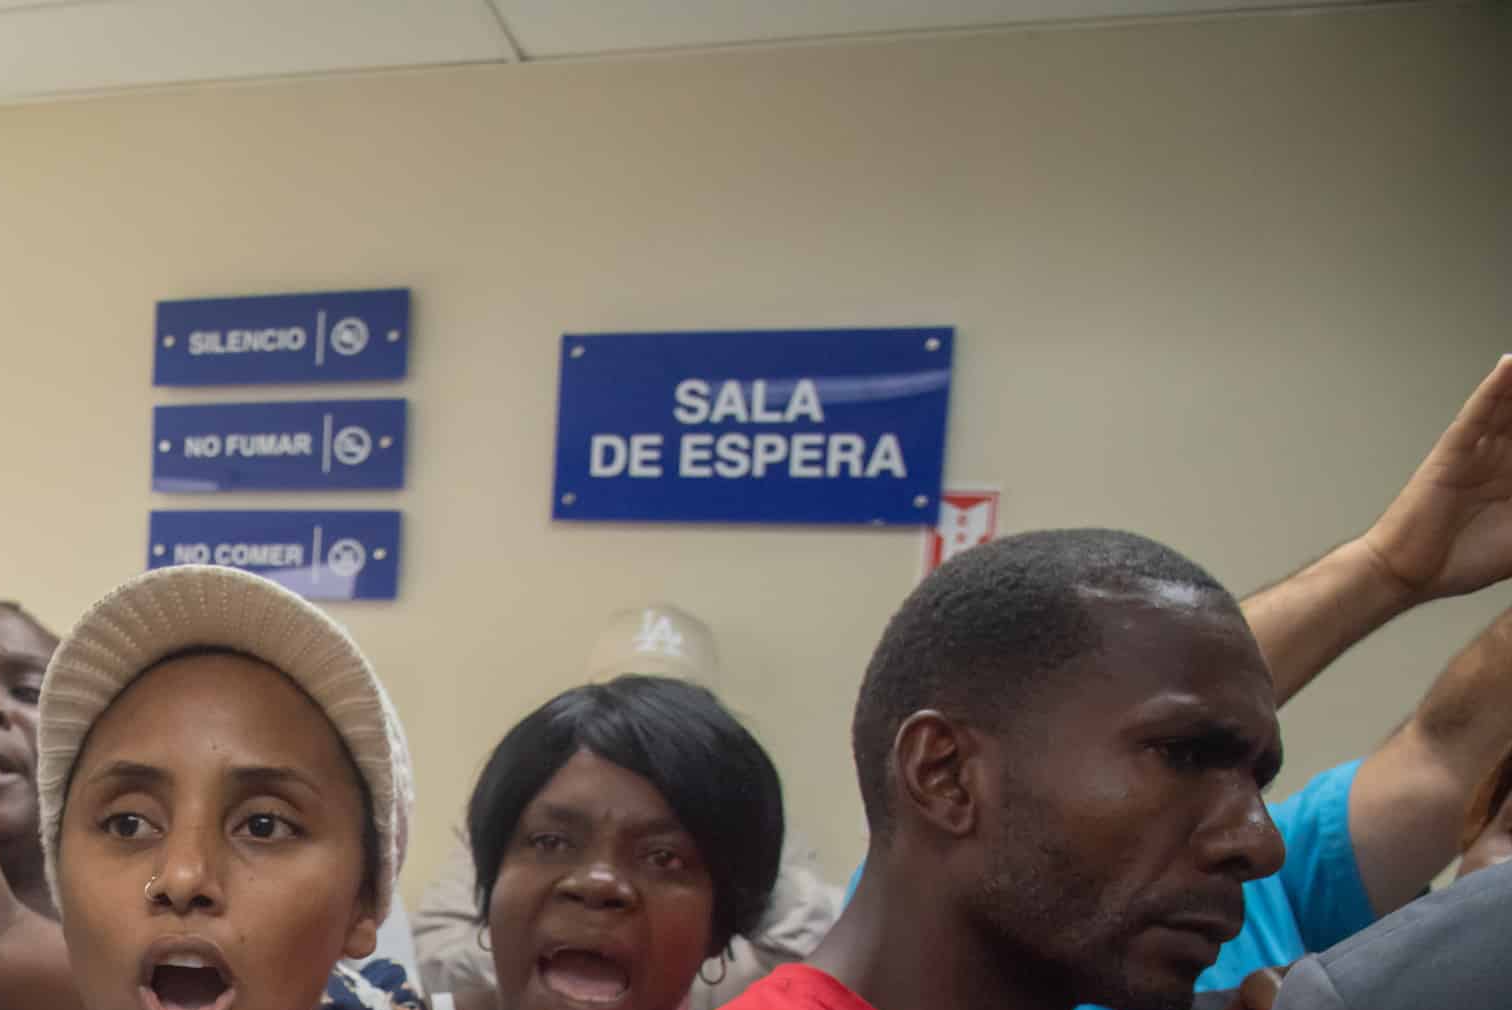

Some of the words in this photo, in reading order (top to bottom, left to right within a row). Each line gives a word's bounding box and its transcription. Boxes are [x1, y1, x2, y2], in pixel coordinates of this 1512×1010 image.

[188, 326, 307, 355] SILENCIO
[673, 378, 824, 424] SALA
[184, 434, 222, 458] NO
[225, 432, 313, 457] FUMAR
[589, 434, 664, 478] DE
[679, 433, 907, 478] ESPERA
[173, 543, 211, 566] NO
[214, 543, 304, 567] COMER
